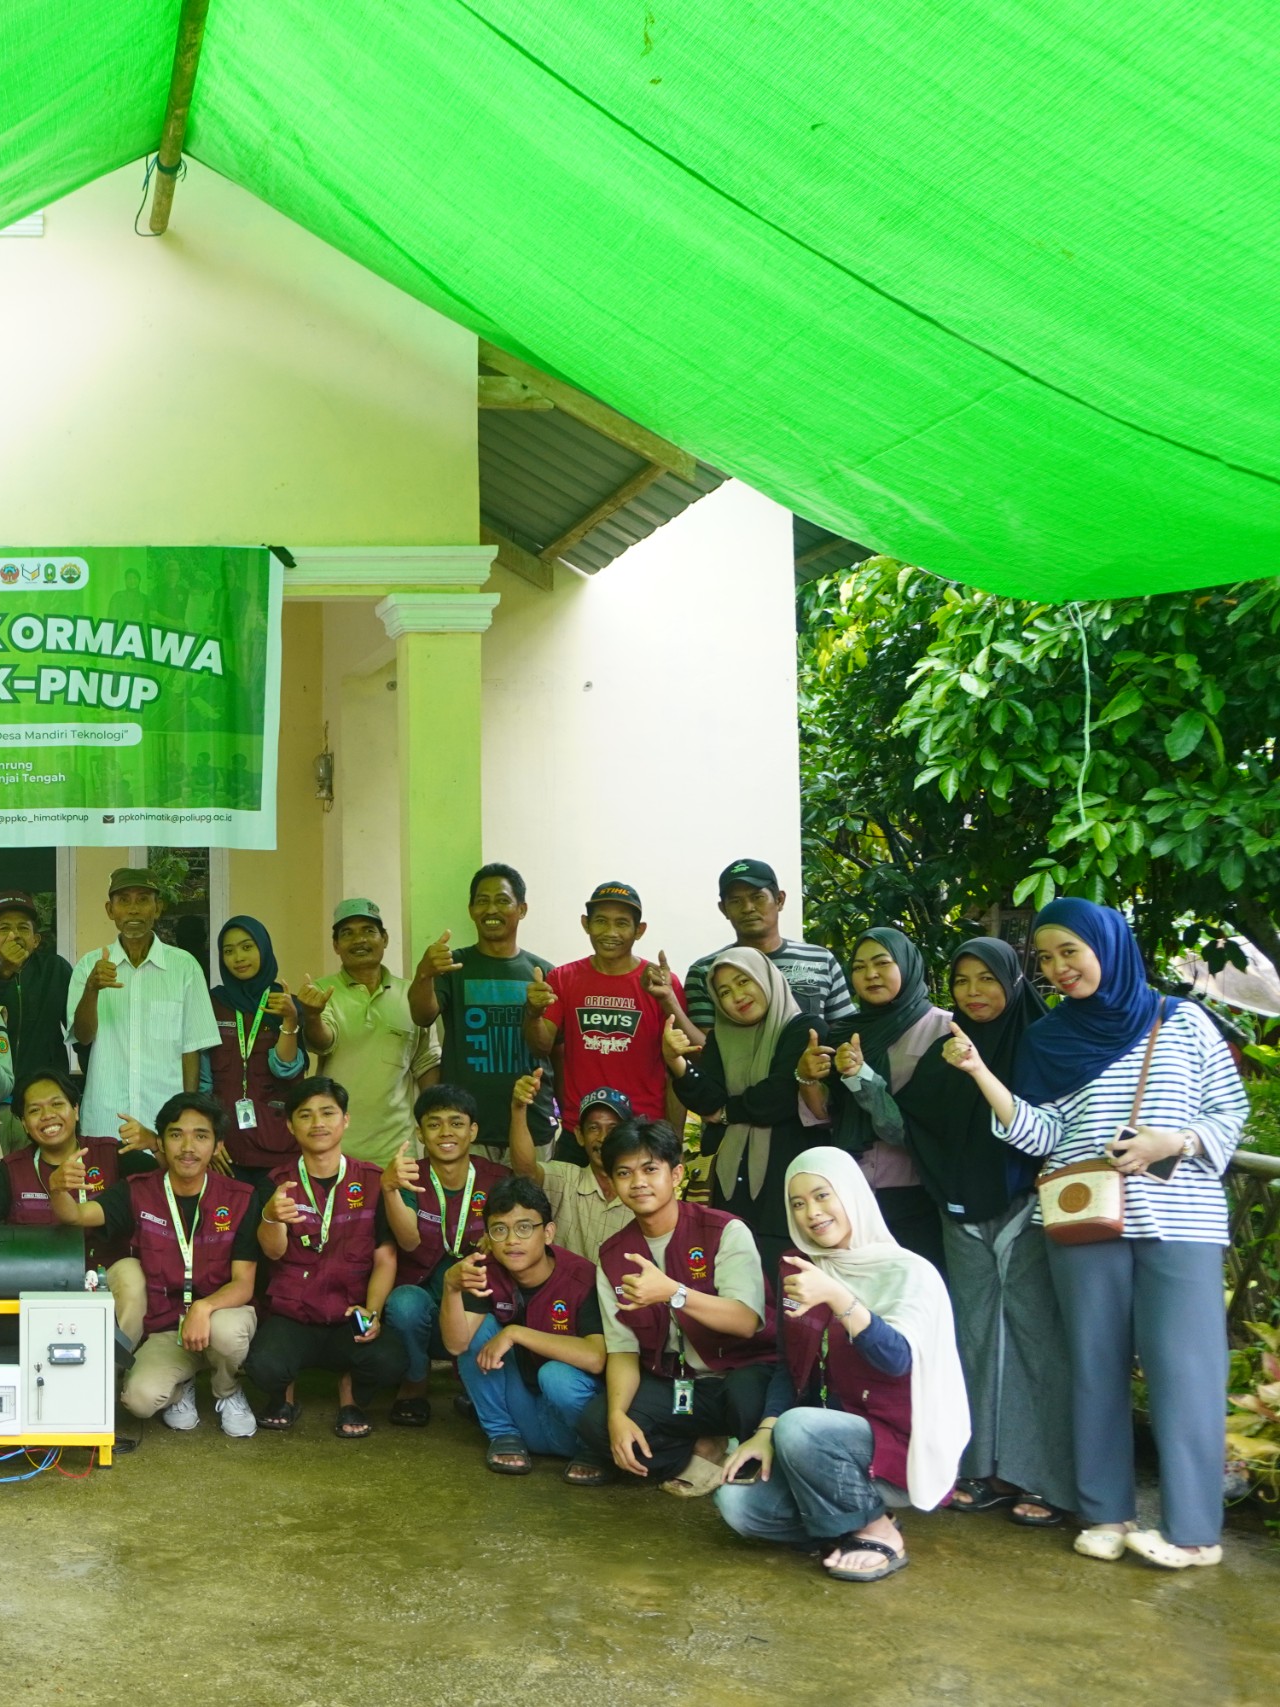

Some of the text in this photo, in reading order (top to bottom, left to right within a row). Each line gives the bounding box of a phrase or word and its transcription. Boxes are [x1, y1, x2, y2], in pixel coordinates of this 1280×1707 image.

[11, 616, 224, 675] ORMAWA
[25, 730, 67, 740] Mandiri
[22, 773, 65, 784] Tengah
[118, 814, 232, 824] ppkohimatik@poliupg.ac.id
[599, 888, 630, 896] STIHL
[585, 996, 636, 1009] ORIGINAL
[465, 1007, 488, 1073] OFF
